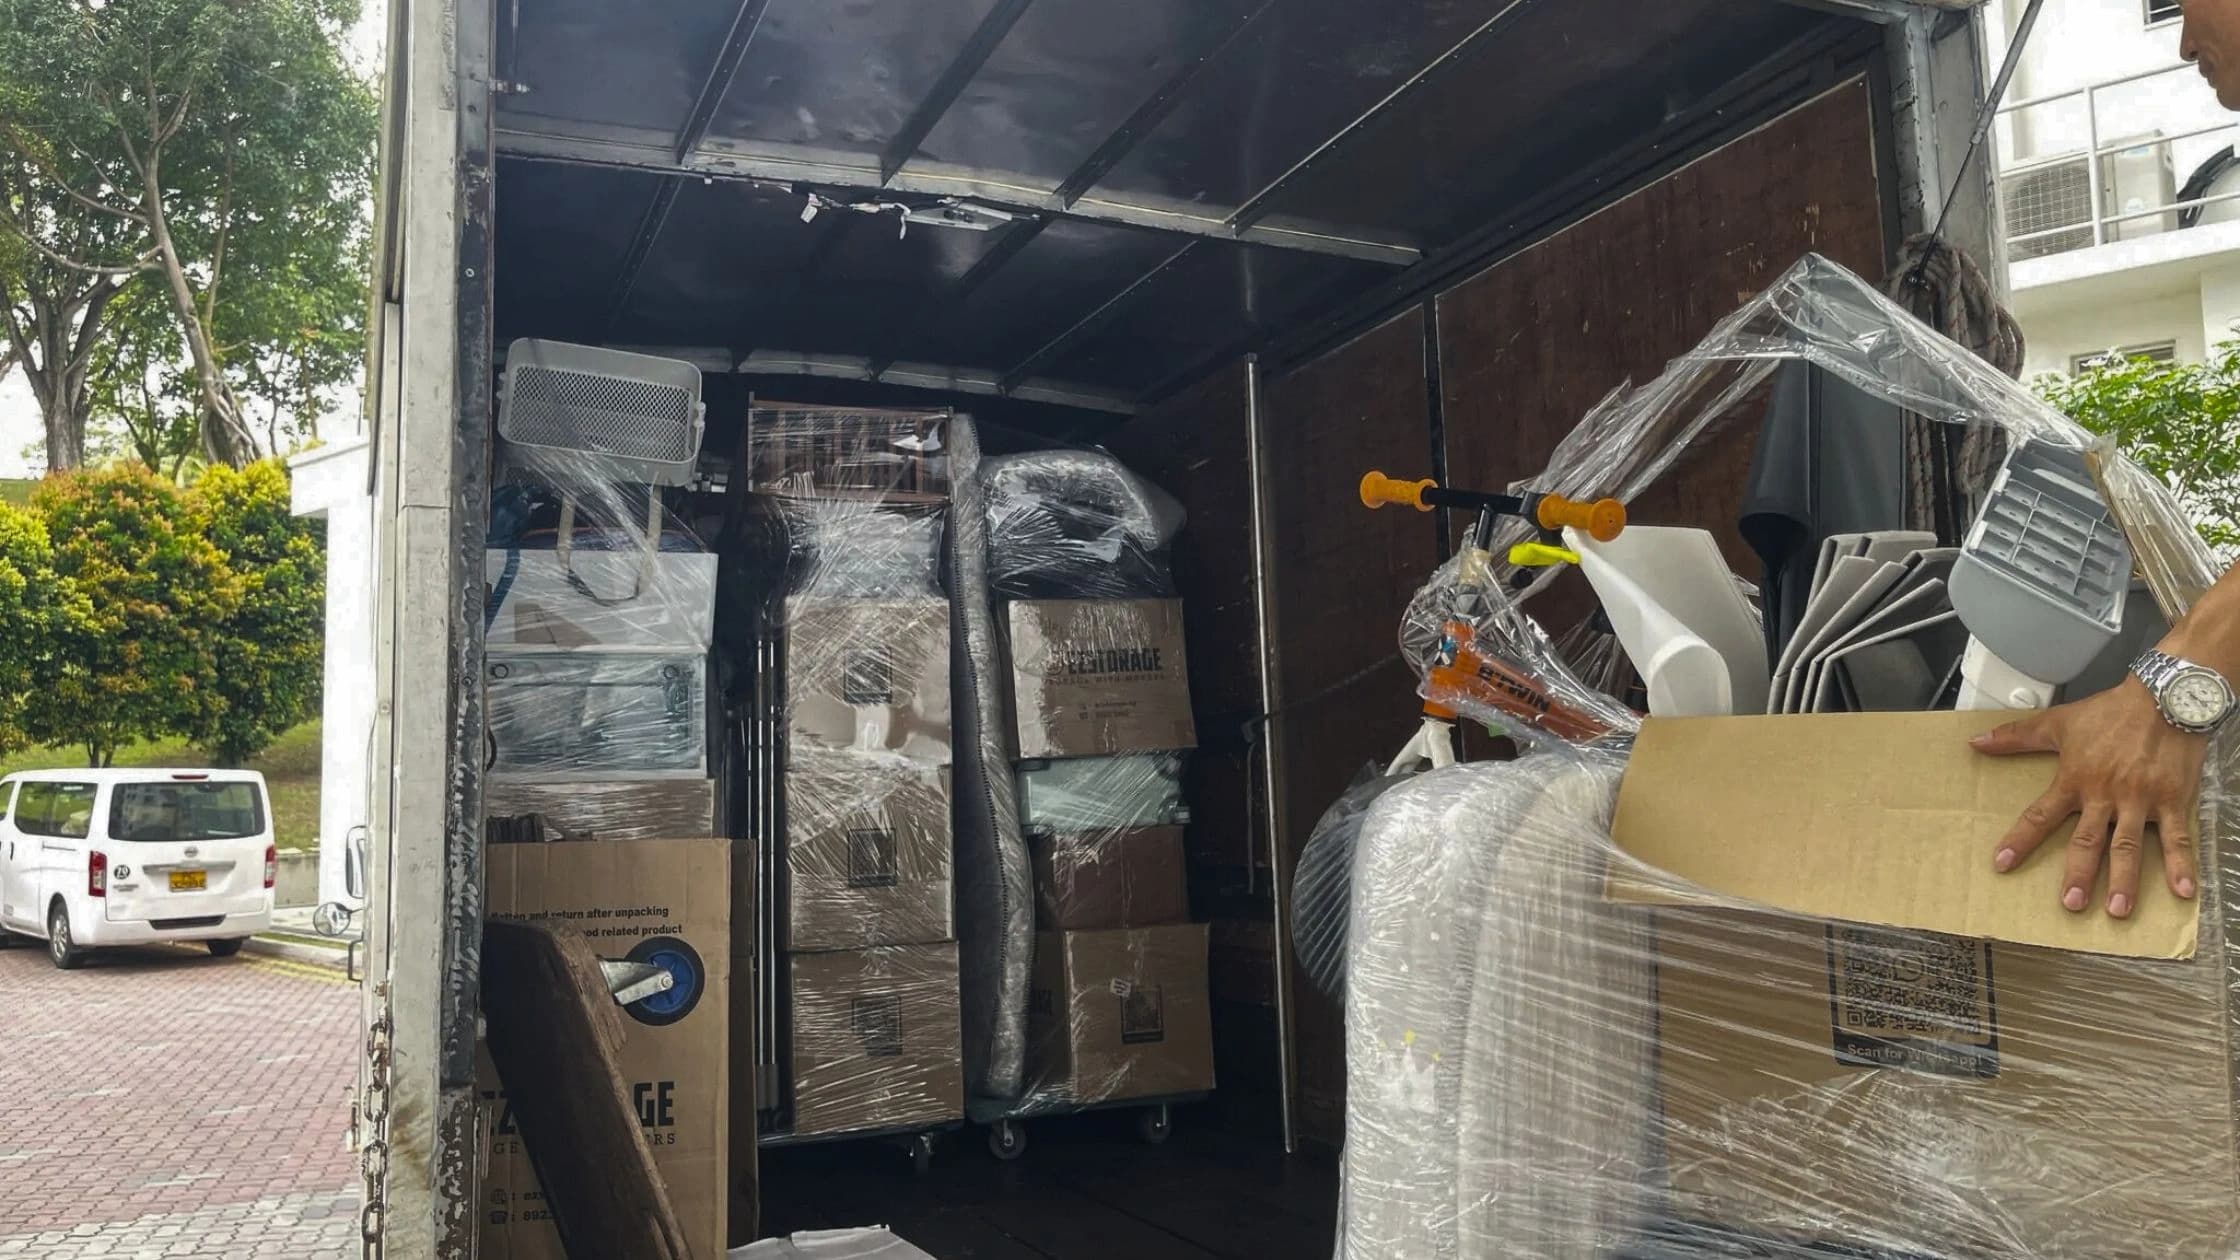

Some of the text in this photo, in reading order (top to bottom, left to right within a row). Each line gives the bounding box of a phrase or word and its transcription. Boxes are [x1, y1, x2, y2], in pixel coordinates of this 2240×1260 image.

[587, 908, 613, 919] after
[615, 906, 669, 919] unpacking
[602, 926, 639, 936] related
[642, 924, 682, 937] product
[1847, 1043, 1881, 1058] Scan
[1885, 1047, 1904, 1059] for
